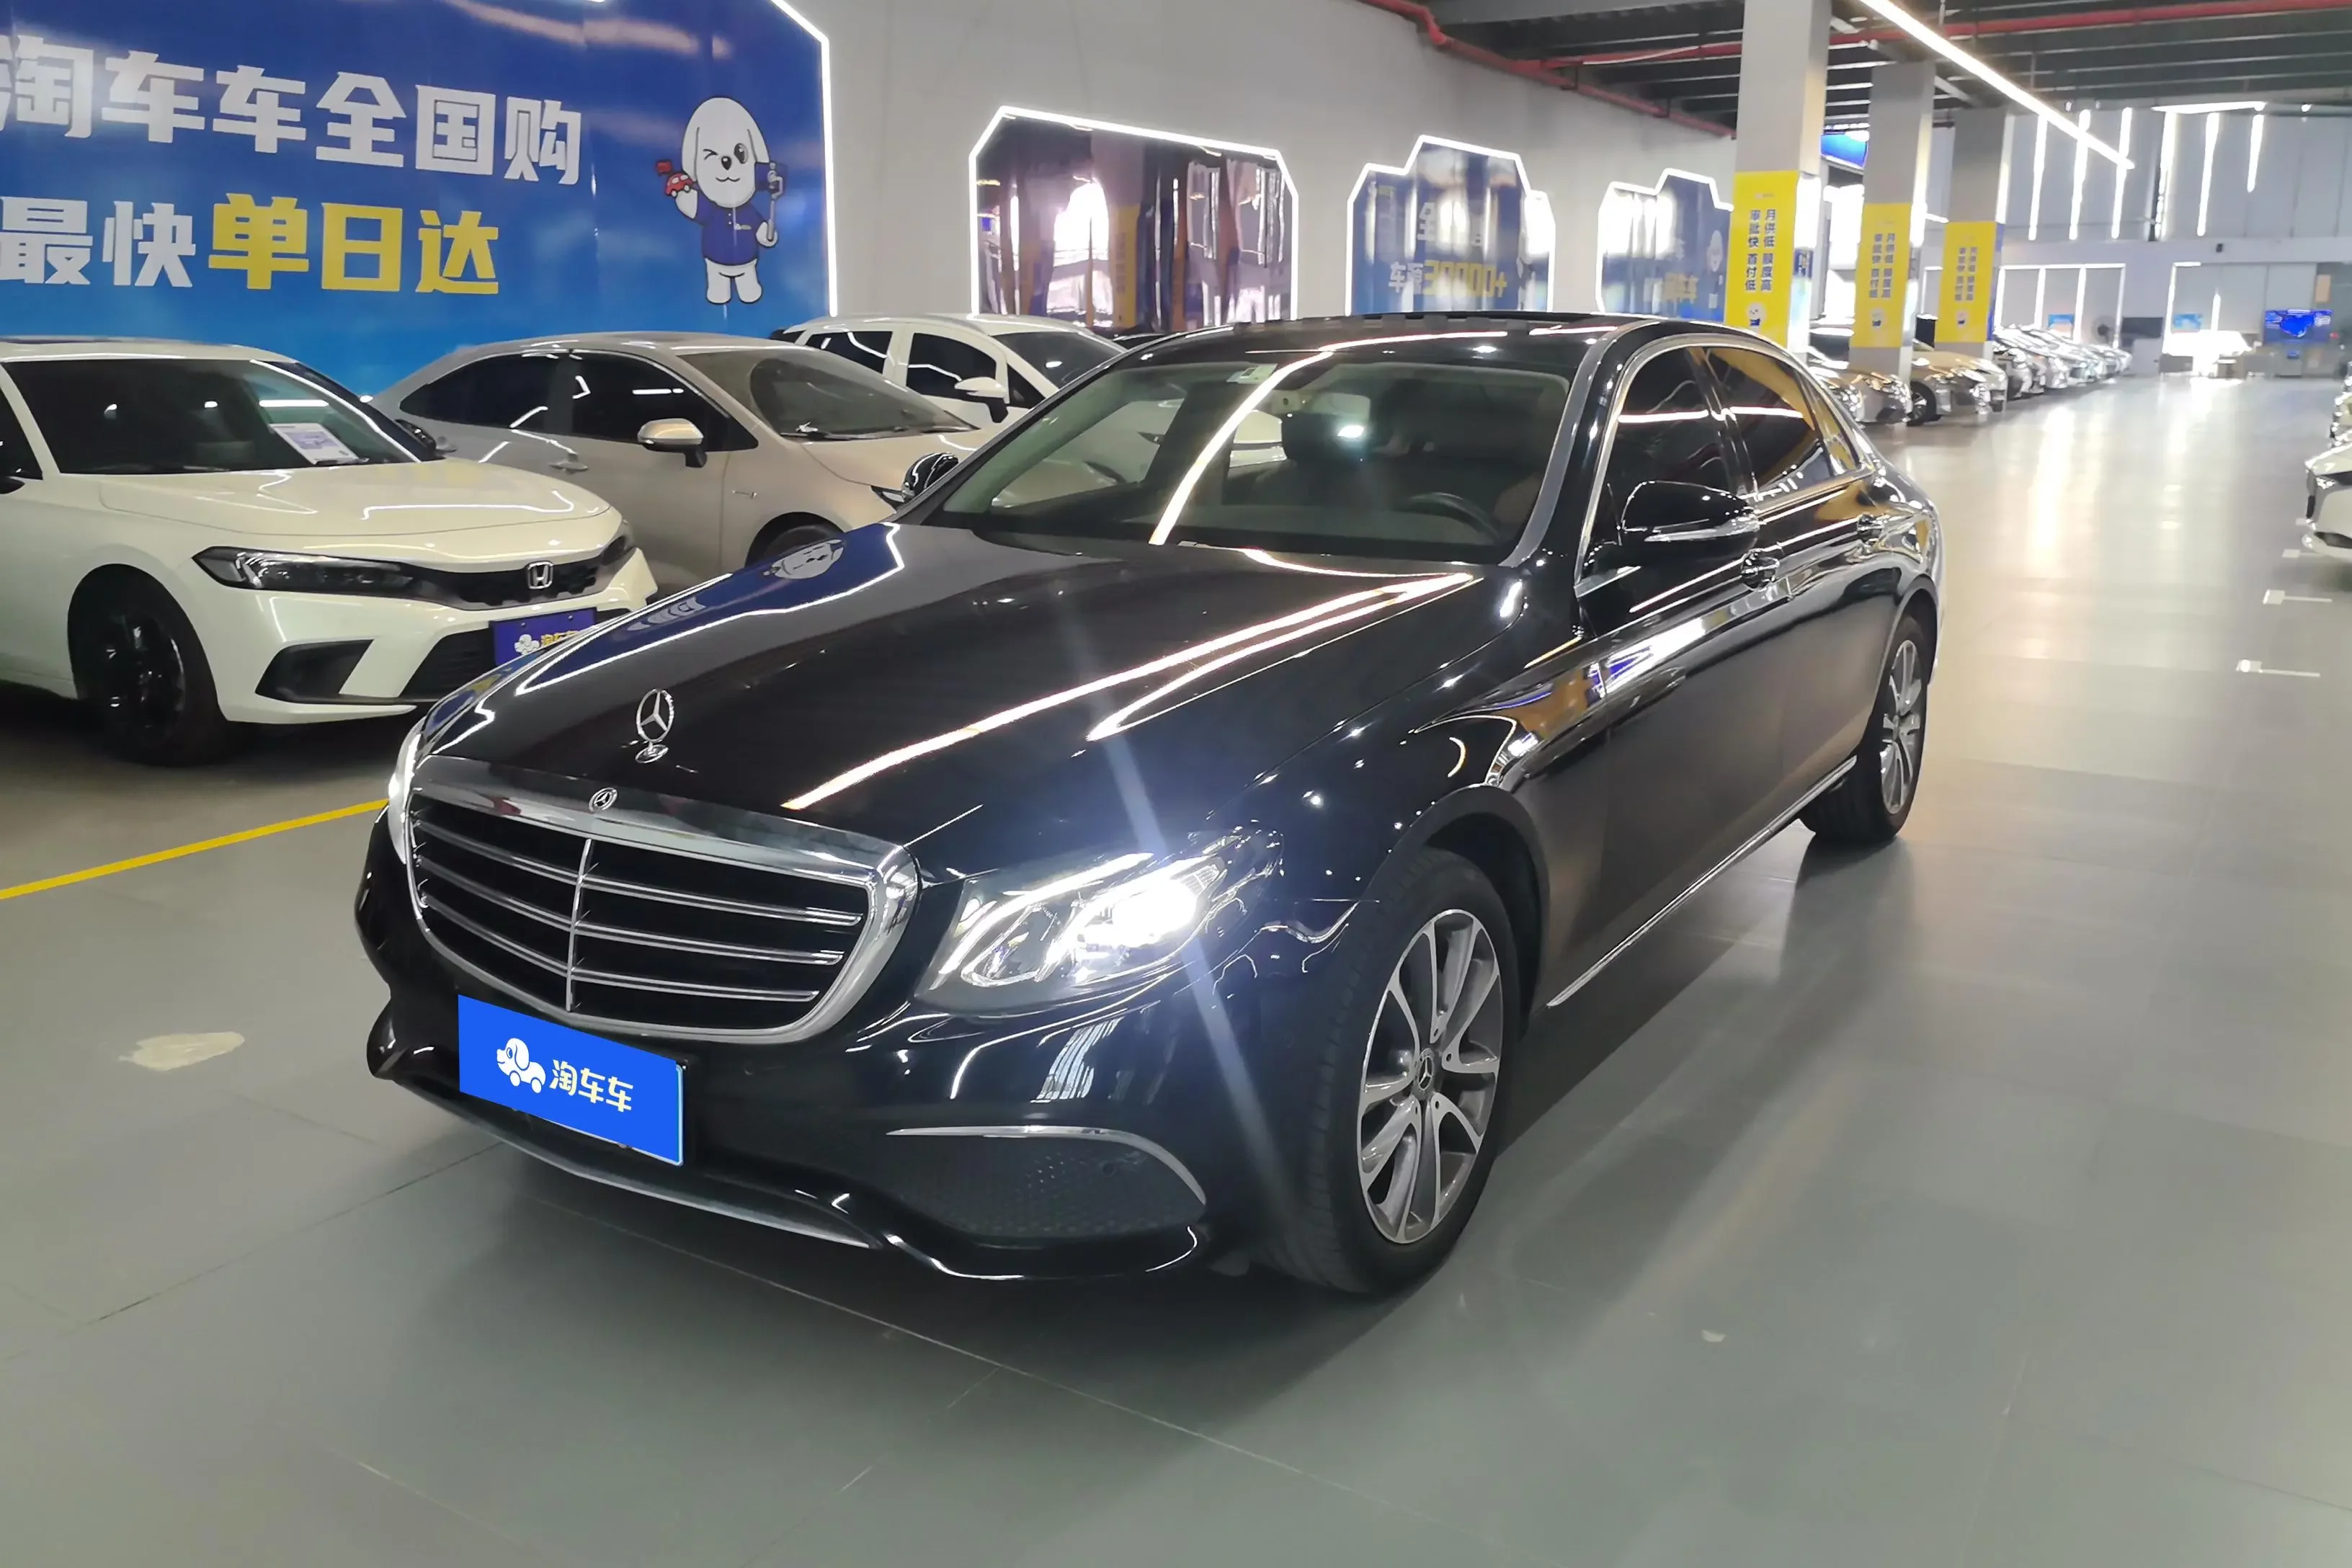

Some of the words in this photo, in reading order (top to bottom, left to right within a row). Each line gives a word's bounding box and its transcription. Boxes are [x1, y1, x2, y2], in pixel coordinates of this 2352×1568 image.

[0, 35, 582, 185] 淘车车全国购
[0, 192, 499, 294] 最快单日达
